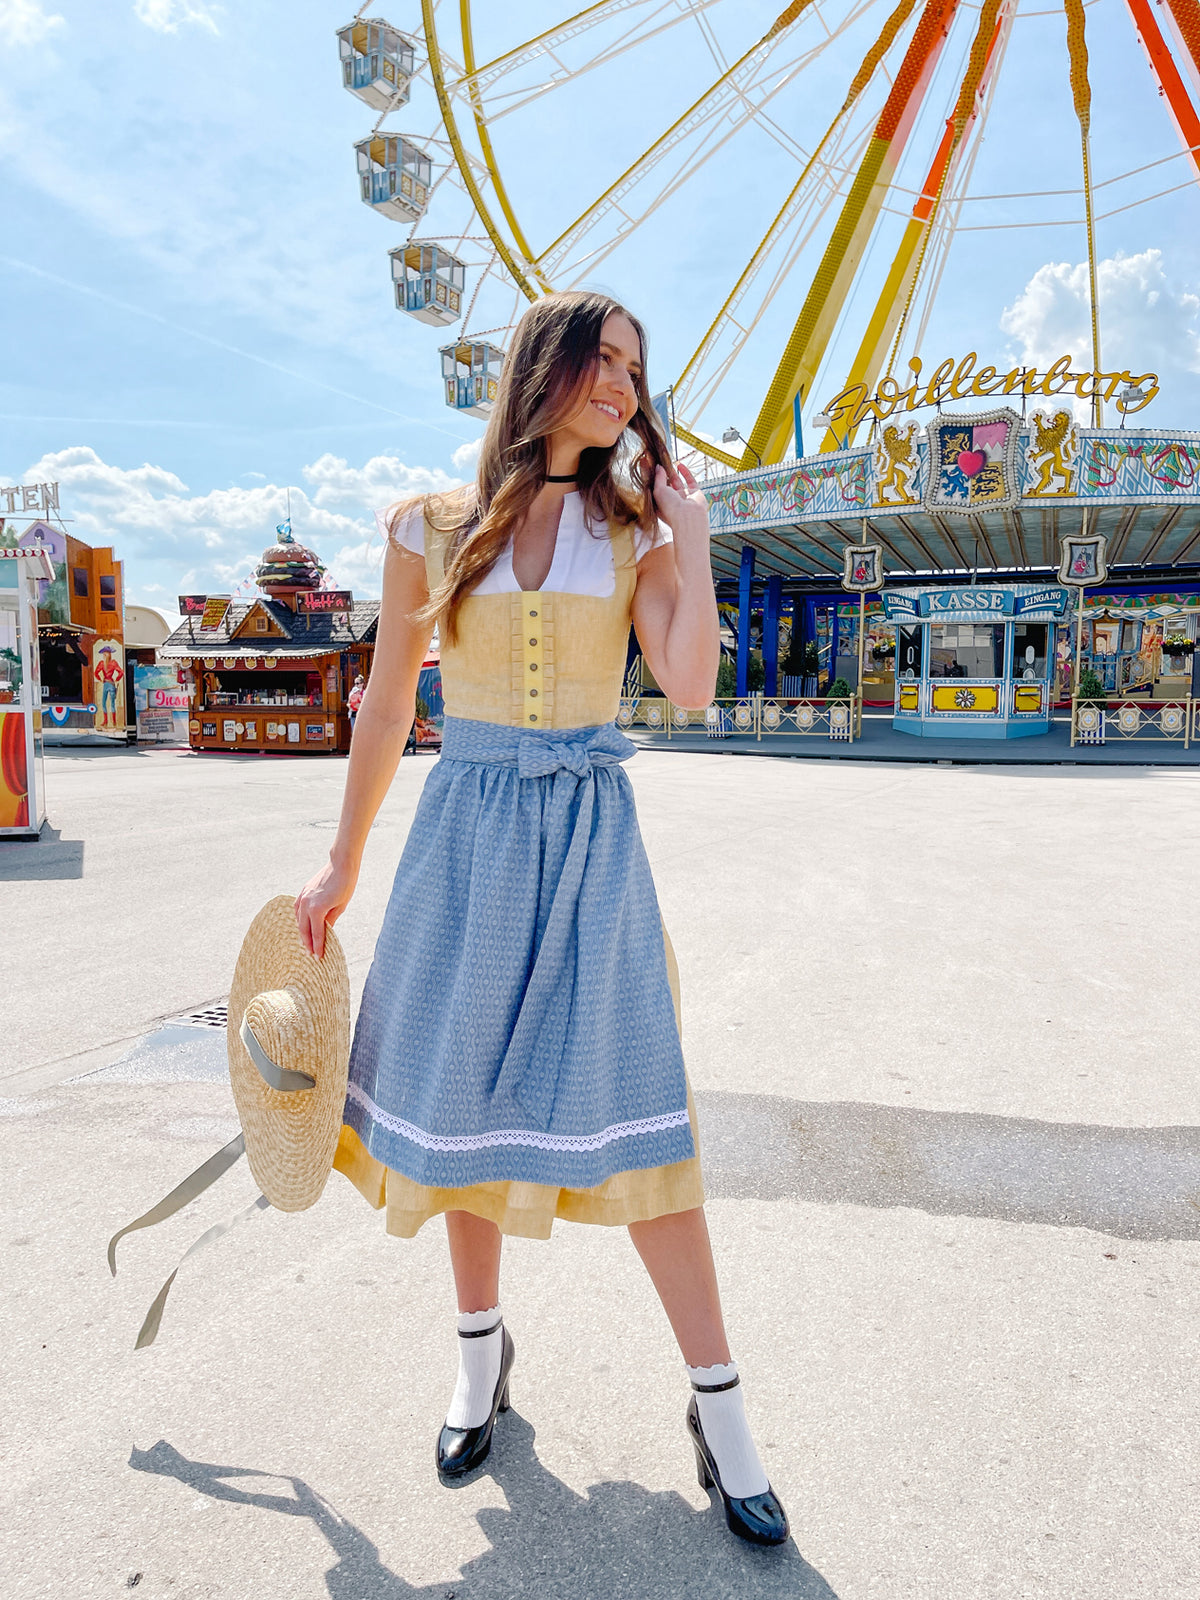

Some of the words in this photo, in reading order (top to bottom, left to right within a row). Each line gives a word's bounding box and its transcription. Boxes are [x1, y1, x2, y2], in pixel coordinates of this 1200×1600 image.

[823, 351, 1160, 427] Willenborg
[887, 596, 913, 609] EINGANG
[927, 591, 1005, 612] KASSE
[1024, 591, 1062, 607] EINGANG
